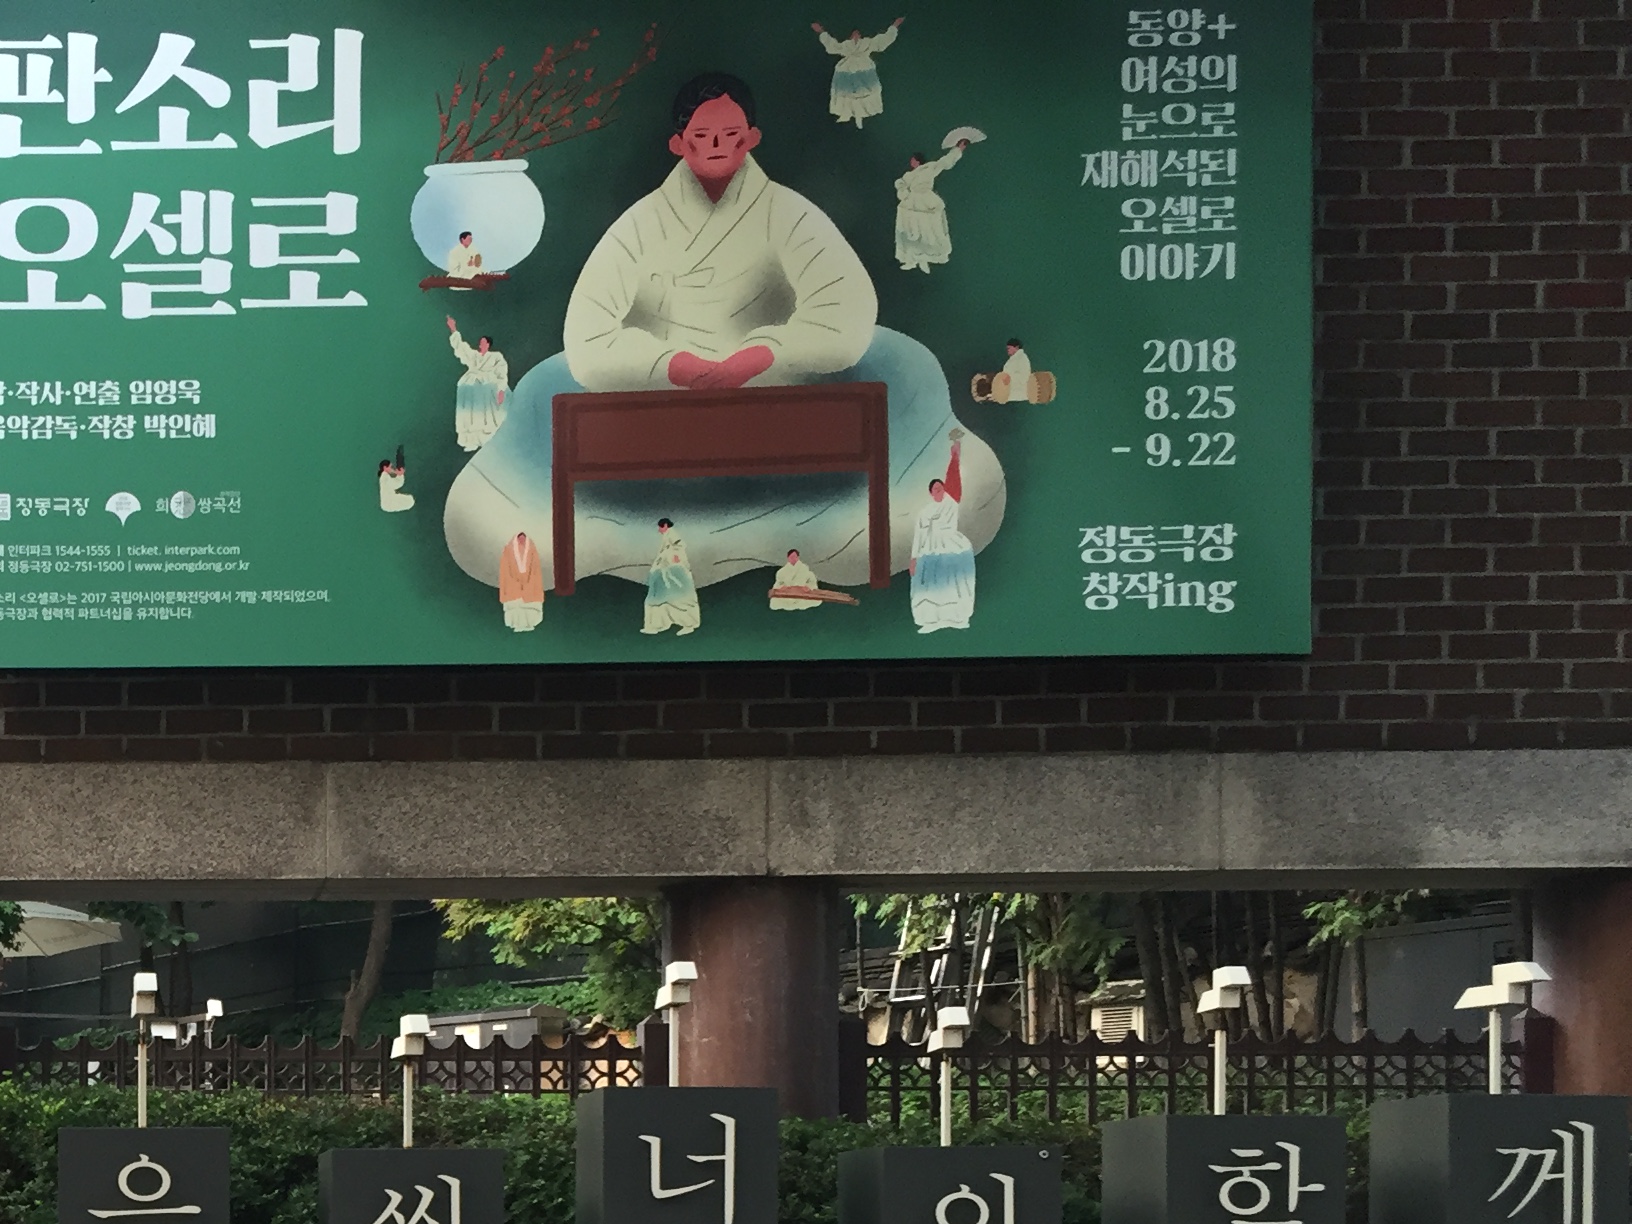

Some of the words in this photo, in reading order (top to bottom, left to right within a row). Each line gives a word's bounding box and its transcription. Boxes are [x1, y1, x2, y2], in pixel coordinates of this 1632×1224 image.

[1126, 8, 1237, 47] 동양+
[1120, 54, 1237, 94] 여성의
[1120, 102, 1238, 141] 눈으로
[1080, 148, 1237, 189] 재해석된
[1119, 195, 1238, 235] 오셀로
[1120, 241, 1237, 282] 이야기
[1142, 337, 1237, 374] 2018
[128, 379, 201, 405] 임영욱
[1144, 385, 1236, 421] 8.25
[143, 413, 216, 440] 박인혜
[15, 497, 91, 517] 정동극장
[7, 544, 53, 557] 인터파크
[55, 545, 112, 557] 1544-1555
[164, 544, 241, 558] interpark.com
[1078, 523, 1239, 564] 정동극장
[7, 560, 53, 573] 정동극장
[54, 561, 125, 573] 02-751-1500
[134, 561, 251, 574] www.jeongdong.or.kr
[80, 592, 107, 604] 2017
[1082, 571, 1238, 614] 창작ing
[77, 607, 133, 621] 파트너십을
